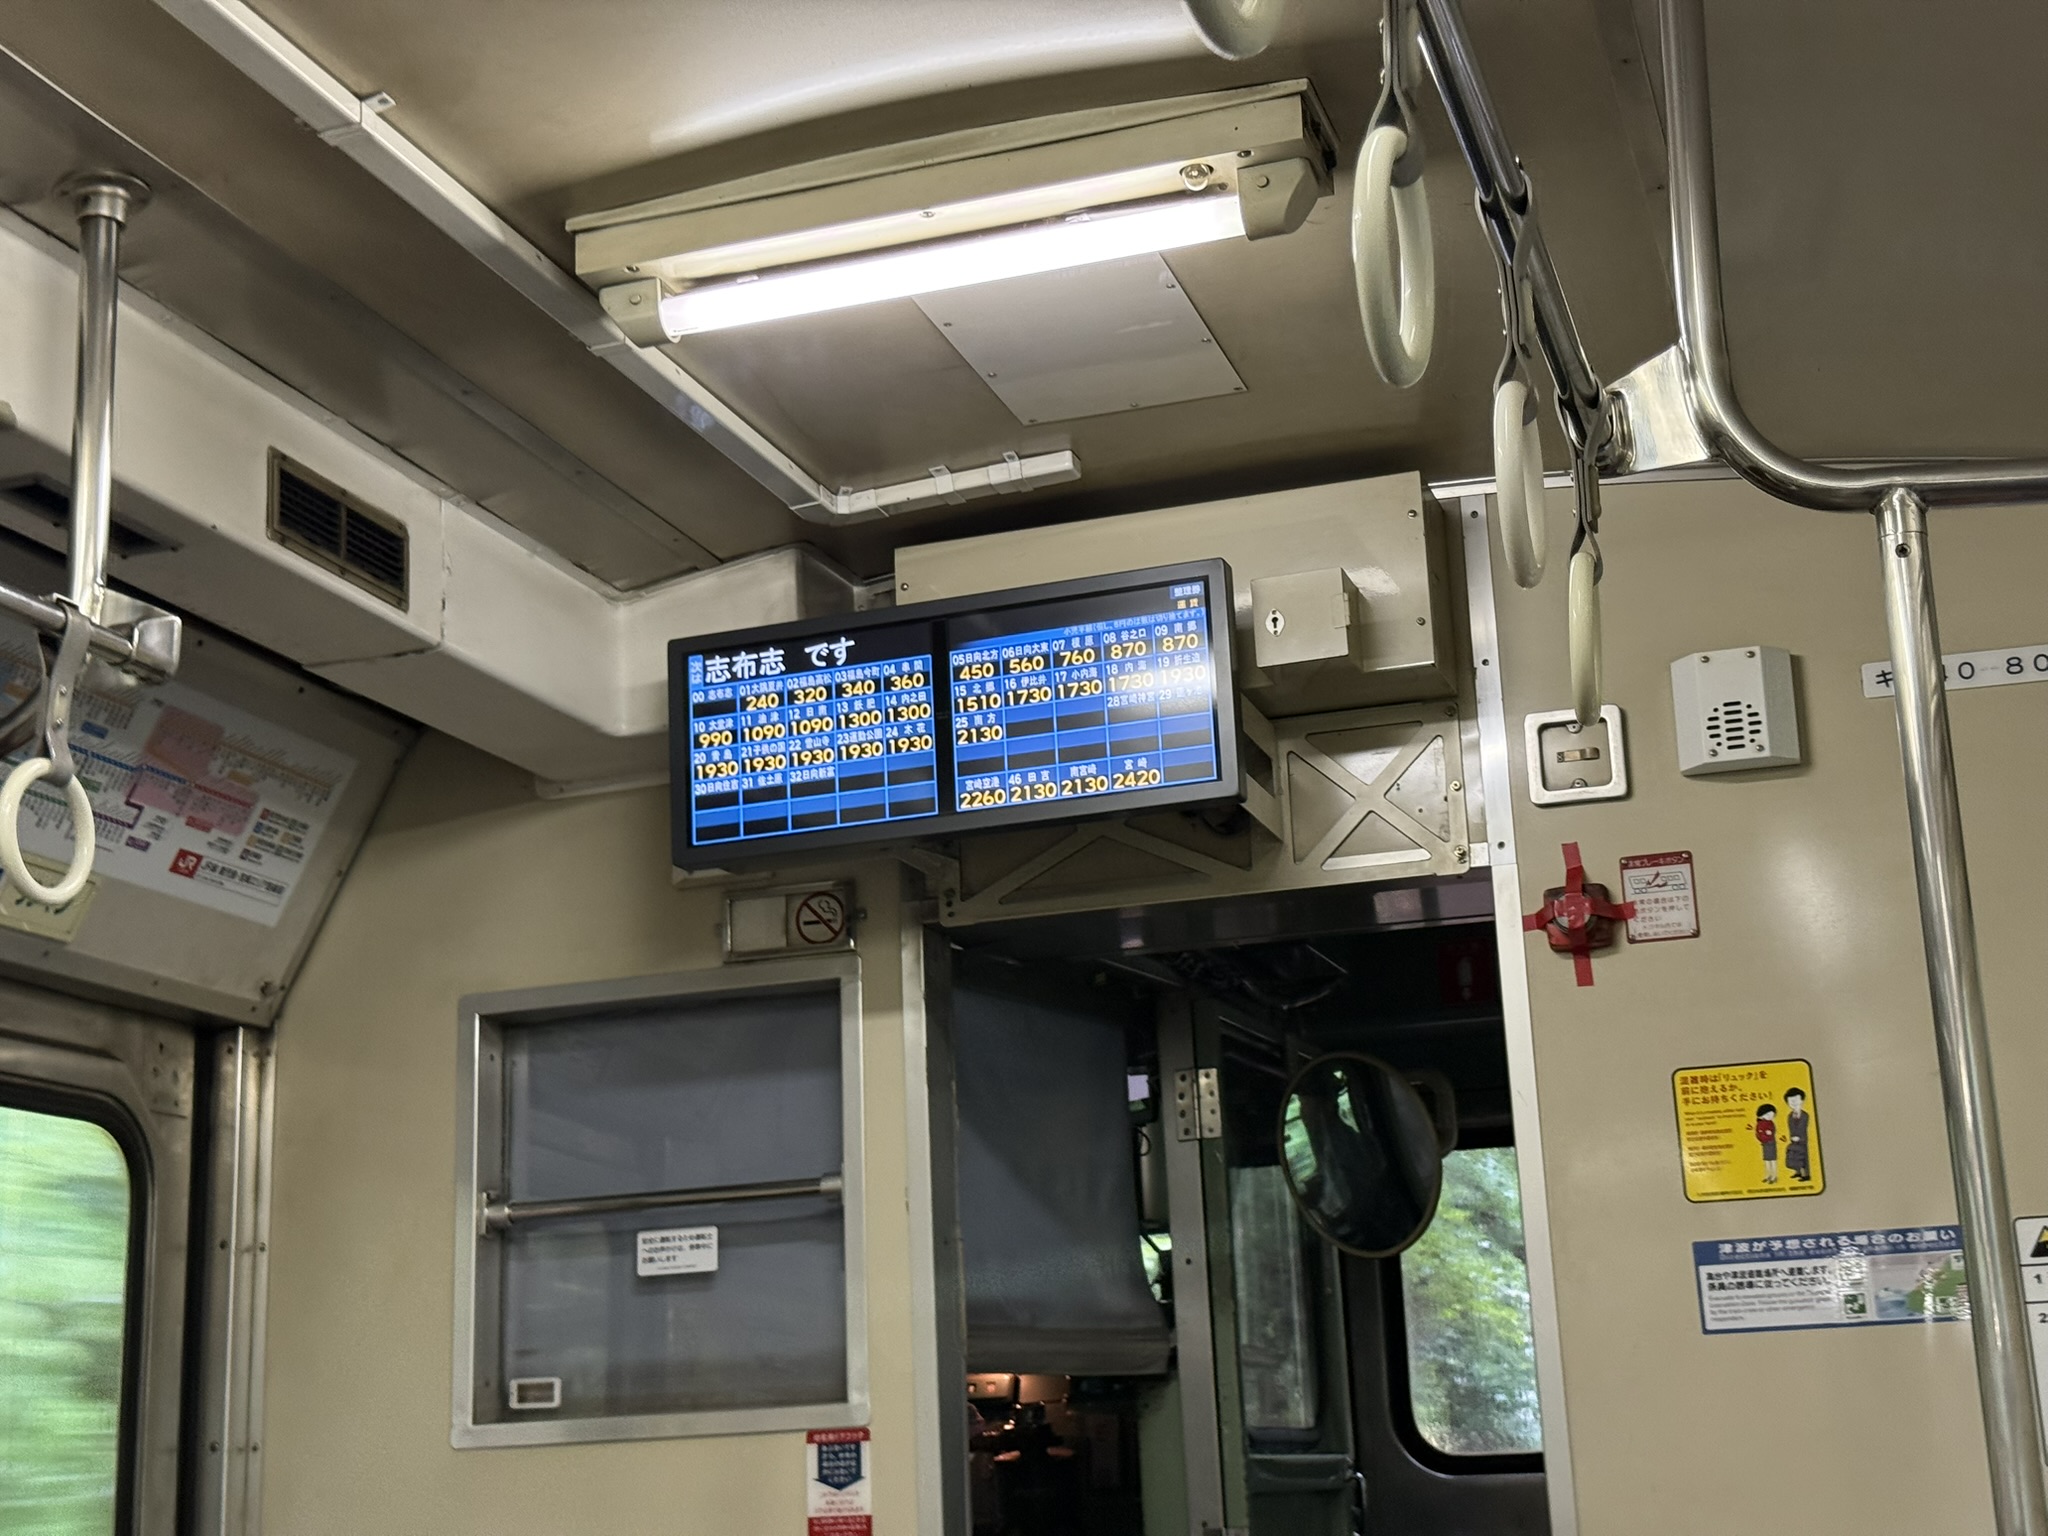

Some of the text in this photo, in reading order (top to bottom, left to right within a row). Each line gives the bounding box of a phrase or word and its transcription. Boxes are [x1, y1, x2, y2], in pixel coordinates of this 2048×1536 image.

[1103, 628, 1146, 644] 08 谷之口
[1155, 625, 1168, 636] 09
[1052, 640, 1065, 651] 07
[1111, 641, 1146, 659] 870
[1162, 634, 1198, 652] 870
[705, 636, 855, 683] 志布志 です
[1010, 656, 1044, 674] 560
[1060, 648, 1095, 666] 760
[1158, 657, 1169, 668] 19
[884, 664, 896, 675] 04
[960, 663, 994, 680] 450
[1055, 671, 1067, 682] 17
[1106, 664, 1118, 675] 18
[1161, 666, 1206, 684] 1930
[842, 680, 875, 697] 340
[891, 673, 924, 691] 360
[955, 685, 966, 696] 15
[1005, 679, 1016, 690] 16
[1058, 680, 1102, 699] 1730
[1108, 673, 1154, 692] 1730
[692, 692, 704, 703] 00
[746, 693, 779, 711] 240
[794, 686, 827, 704] 320
[886, 696, 897, 706] 14
[1007, 686, 1052, 706] 1730
[1160, 689, 1172, 699] 29
[837, 702, 848, 713] 13
[888, 703, 931, 722] 1300
[958, 694, 1001, 713] 1510
[741, 715, 751, 726] 11
[789, 709, 800, 719] 12
[839, 710, 882, 730] 1300
[956, 717, 968, 728] 25
[694, 722, 705, 732] 10
[744, 724, 785, 742] 1090
[791, 717, 833, 736] 1090
[886, 726, 898, 737] 24
[957, 725, 1002, 745] 2130
[699, 731, 732, 748] 990
[789, 740, 801, 750] 22
[889, 735, 932, 754] 1930
[694, 752, 706, 764] 20
[792, 748, 834, 767] 1930
[840, 742, 883, 760] 1930
[697, 761, 738, 780] 1930
[744, 754, 786, 773] 1930
[1124, 757, 1147, 770] 宮崎
[742, 778, 753, 788] 31
[1009, 774, 1022, 785] 46
[1061, 776, 1108, 796] 2130
[1113, 769, 1160, 789] 2420
[960, 789, 1006, 809] 2260
[1010, 783, 1056, 802] 2130
